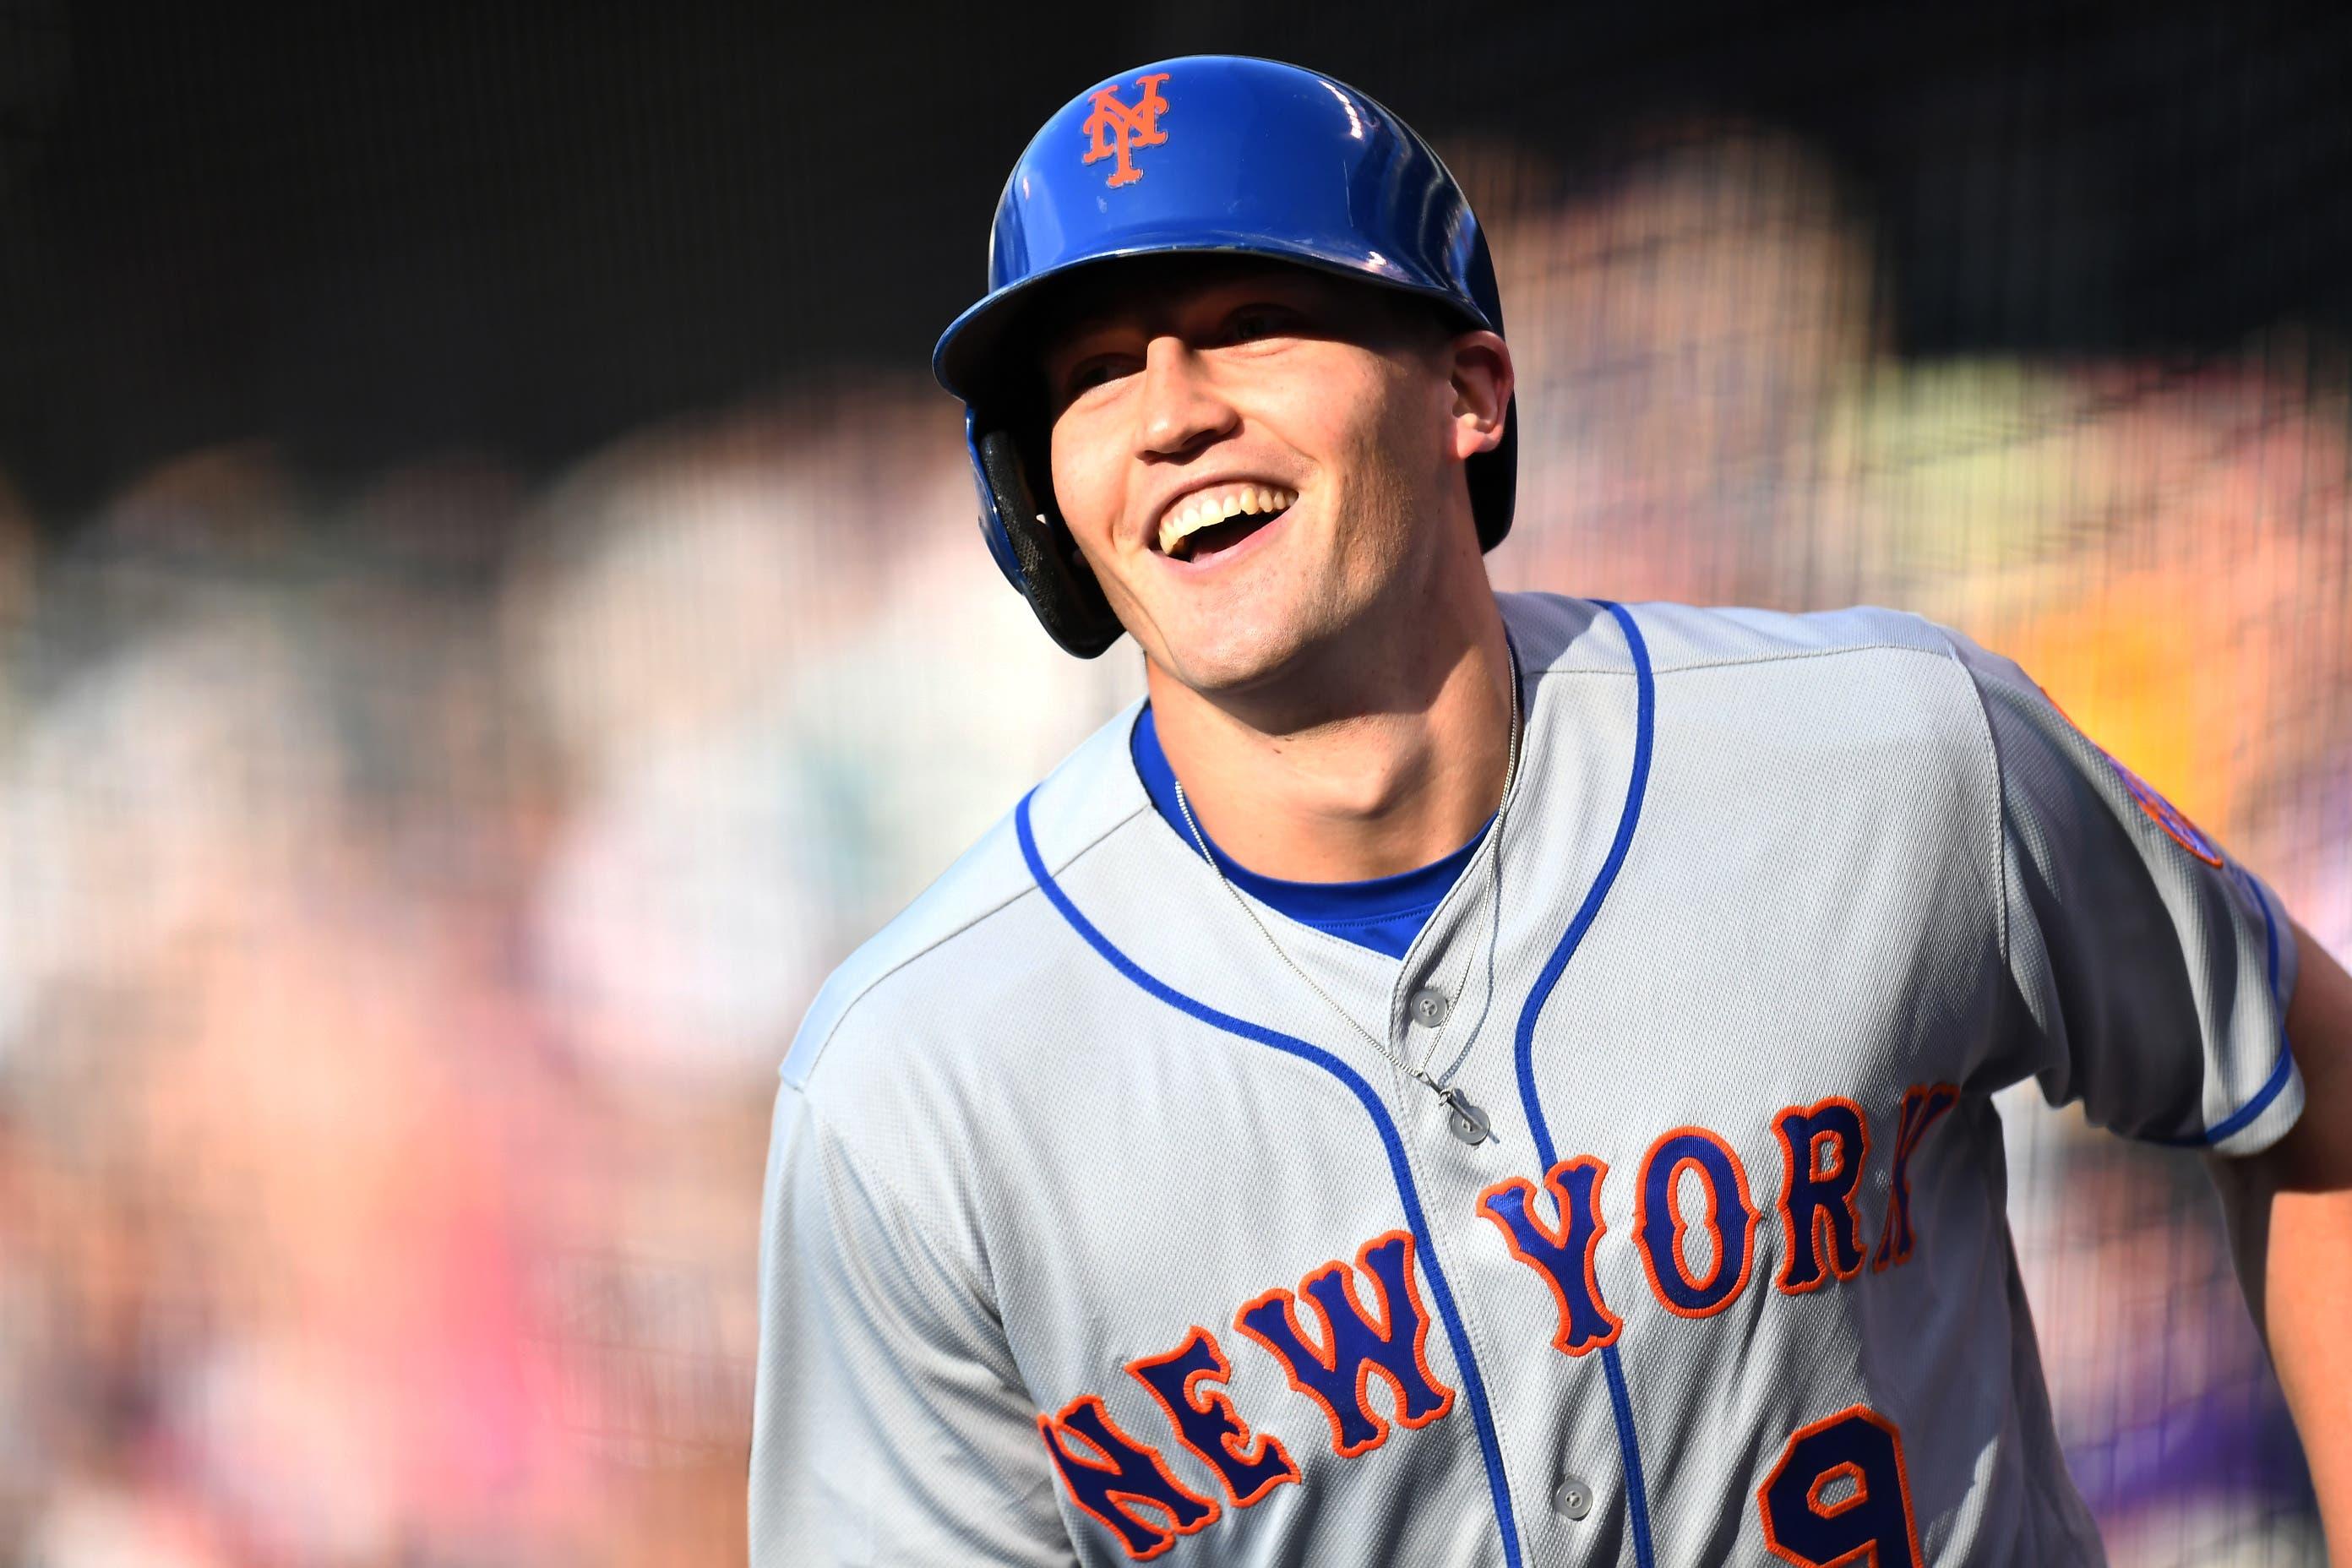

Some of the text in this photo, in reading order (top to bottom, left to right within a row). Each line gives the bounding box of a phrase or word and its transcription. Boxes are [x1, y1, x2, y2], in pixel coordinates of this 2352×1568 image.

[1082, 73, 1171, 188] NY
[1037, 1084, 1961, 1561] NEW YORK
[1756, 1403, 1925, 1568] 9
